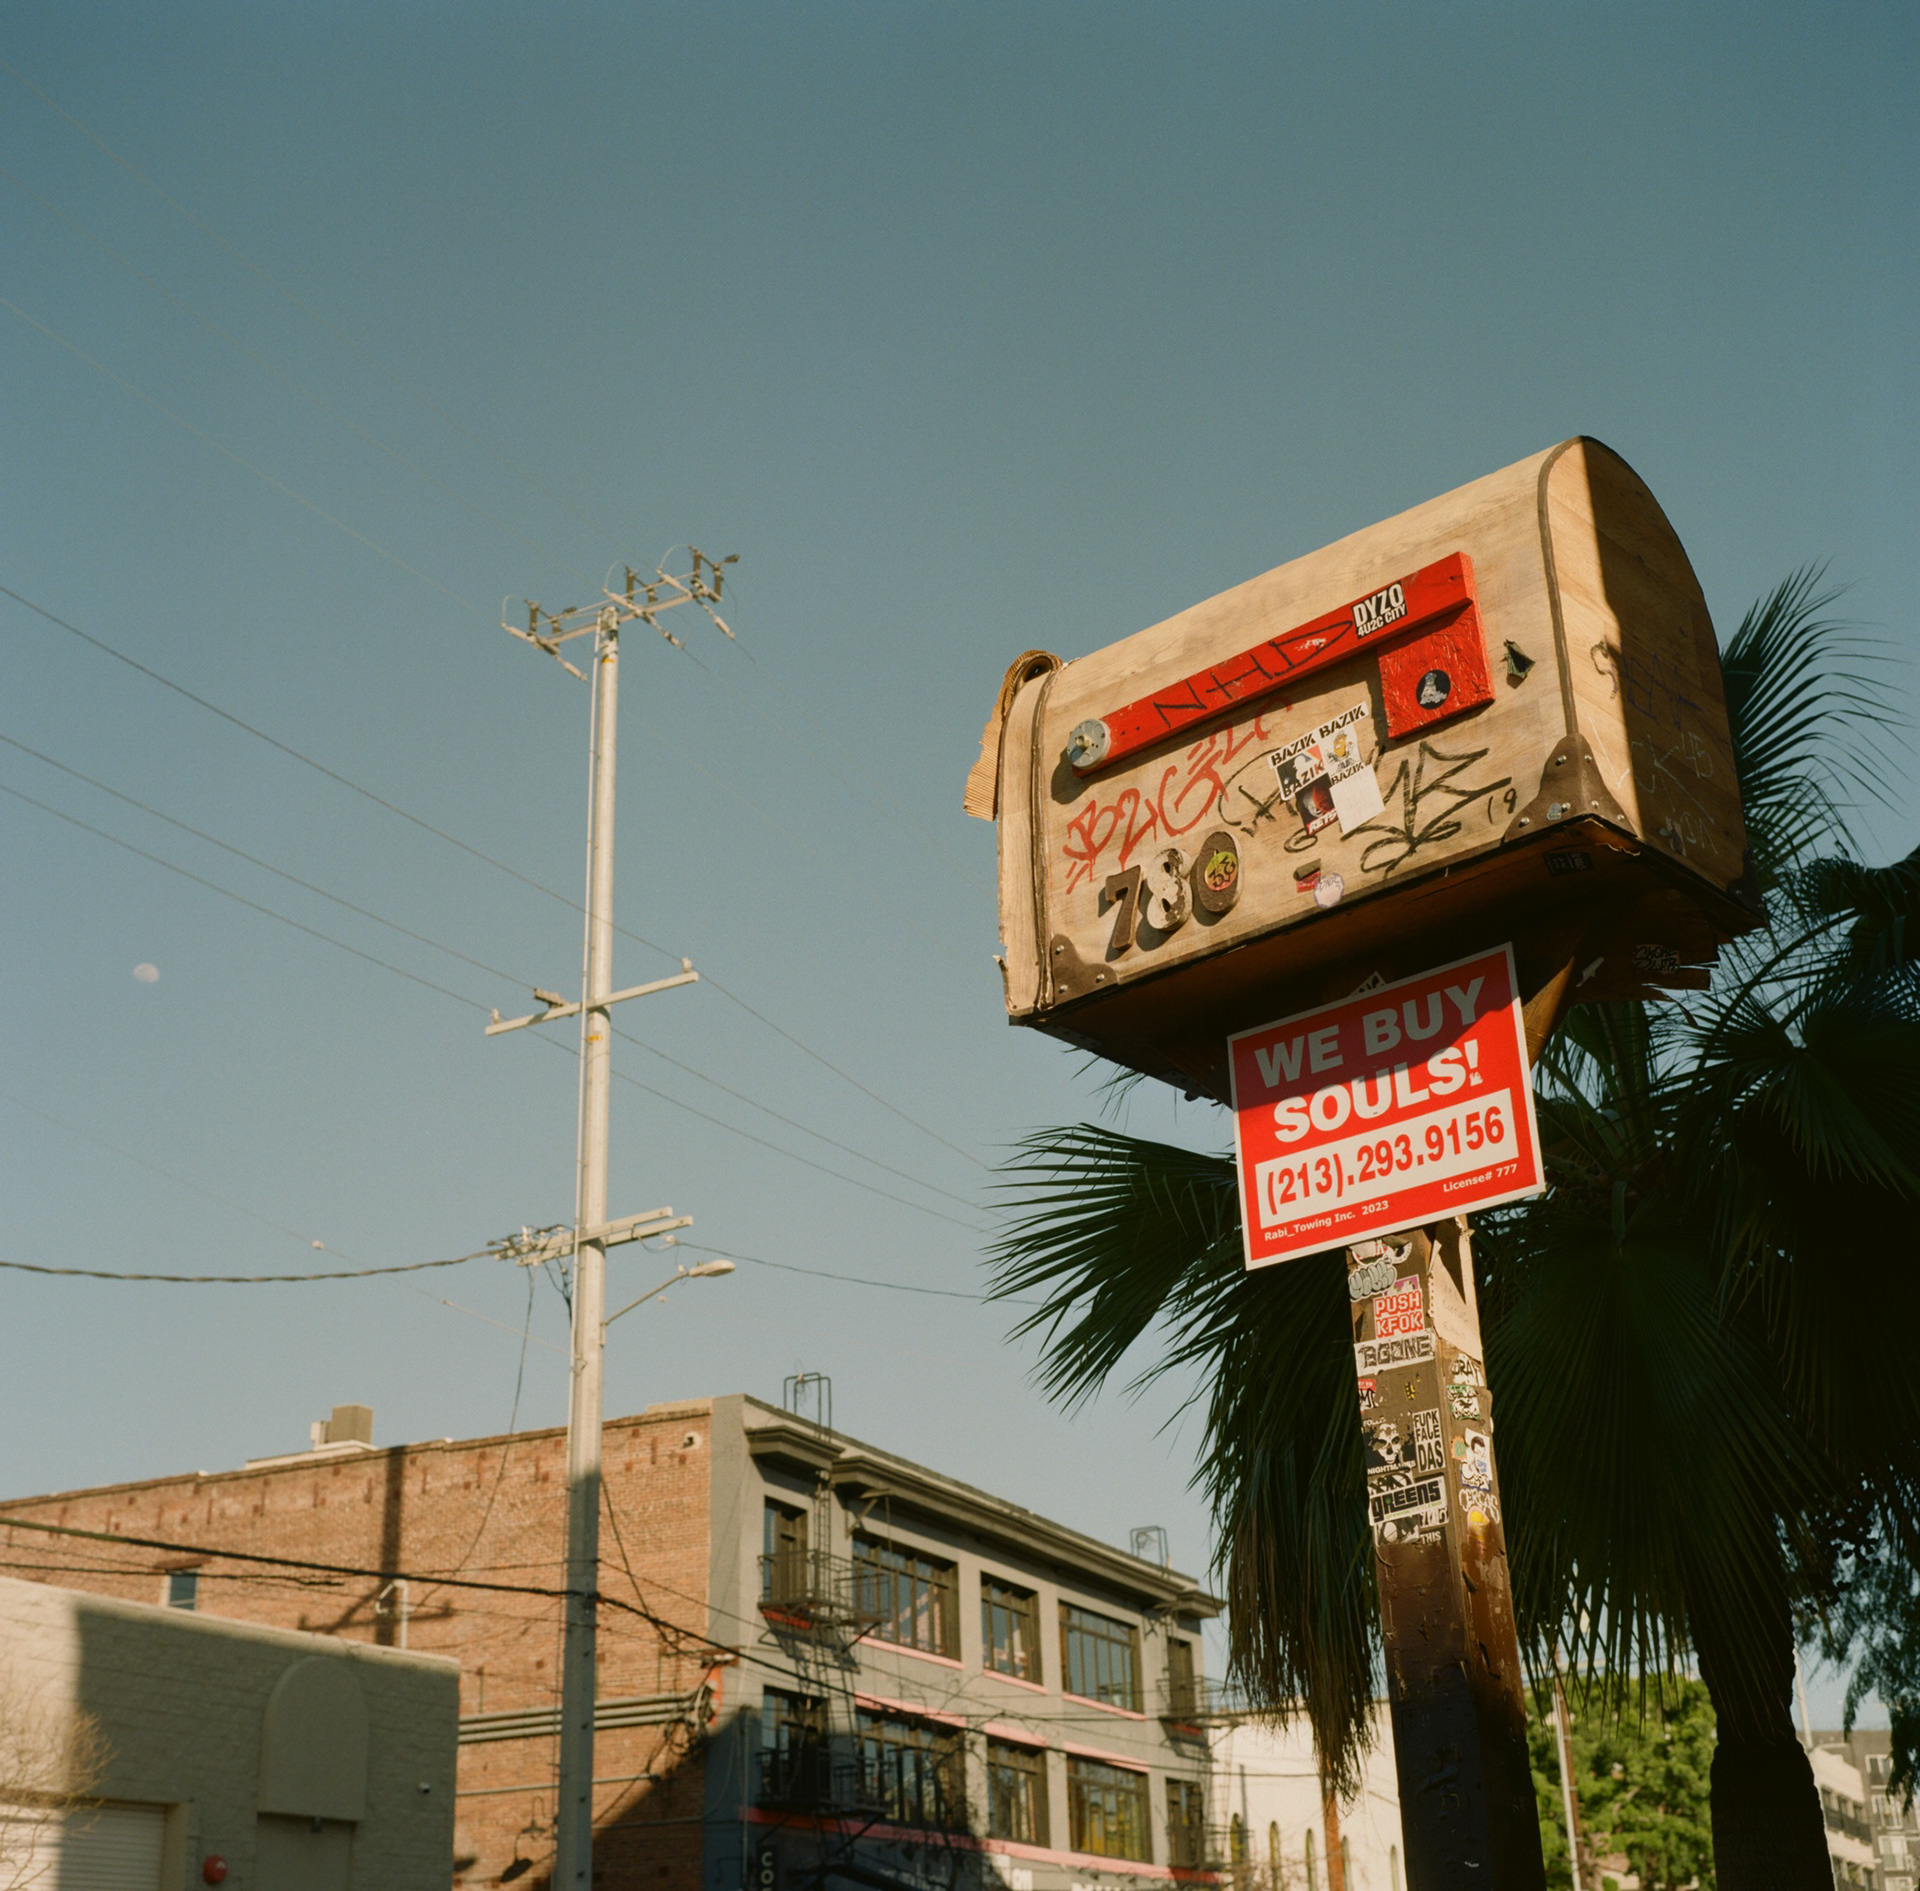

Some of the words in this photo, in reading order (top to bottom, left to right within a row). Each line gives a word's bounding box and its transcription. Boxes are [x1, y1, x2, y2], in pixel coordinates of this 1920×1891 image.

[1353, 583, 1404, 627] DYZO
[1358, 616, 1384, 636] 4U2C
[1384, 604, 1405, 623] CITY
[1271, 733, 1316, 766] BAZIK
[1319, 705, 1367, 738] BAZIK
[1284, 758, 1325, 798] BAZIK
[1331, 762, 1365, 785] BAZIK
[1105, 831, 1243, 950] 780
[1254, 1026, 1344, 1089] WE
[1362, 975, 1486, 1057] BUY
[1273, 1039, 1484, 1143] SOULS!
[1267, 1106, 1506, 1216] (213).293.9156
[1443, 1171, 1493, 1192] License#
[1497, 1163, 1518, 1178] 777
[1264, 1216, 1332, 1241] Rabi_Towing
[1335, 1210, 1356, 1222] Inc.
[1362, 1200, 1389, 1215] 2023
[1375, 1291, 1421, 1317] PUSH
[1414, 1410, 1439, 1430] FUCK
[1417, 1440, 1443, 1472] DAS
[1420, 1531, 1442, 1545] THIS
[761, 1851, 774, 1891] CO
